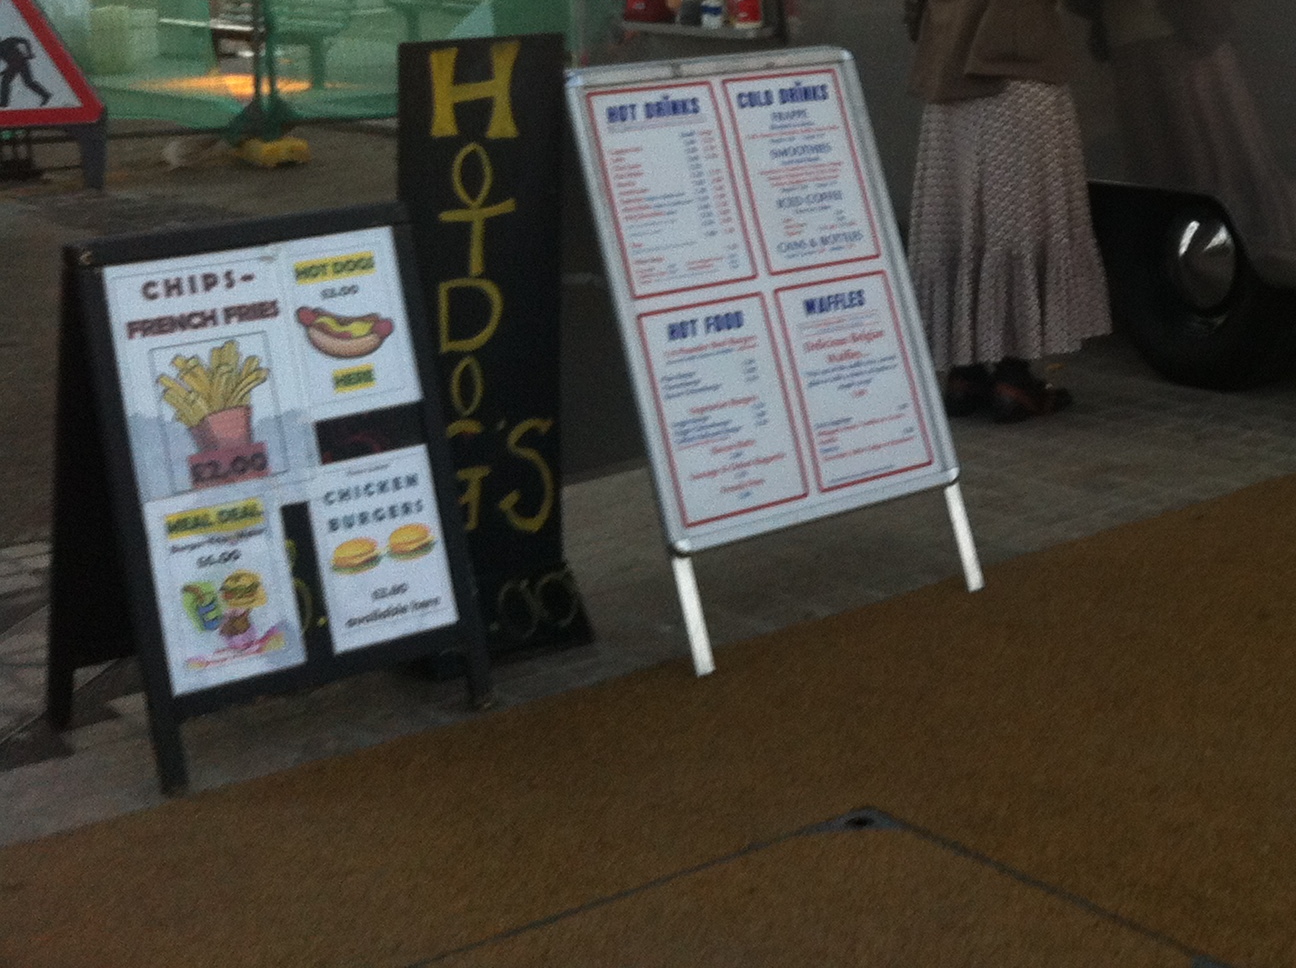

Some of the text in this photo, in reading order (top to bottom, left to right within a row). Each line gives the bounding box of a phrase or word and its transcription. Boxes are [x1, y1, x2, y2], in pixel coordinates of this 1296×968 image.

[126, 298, 280, 340] FRENCH FRIES
[803, 288, 865, 316] WAFFLES
[323, 472, 419, 506] CHICKEN
[327, 498, 424, 532] BURGERS
